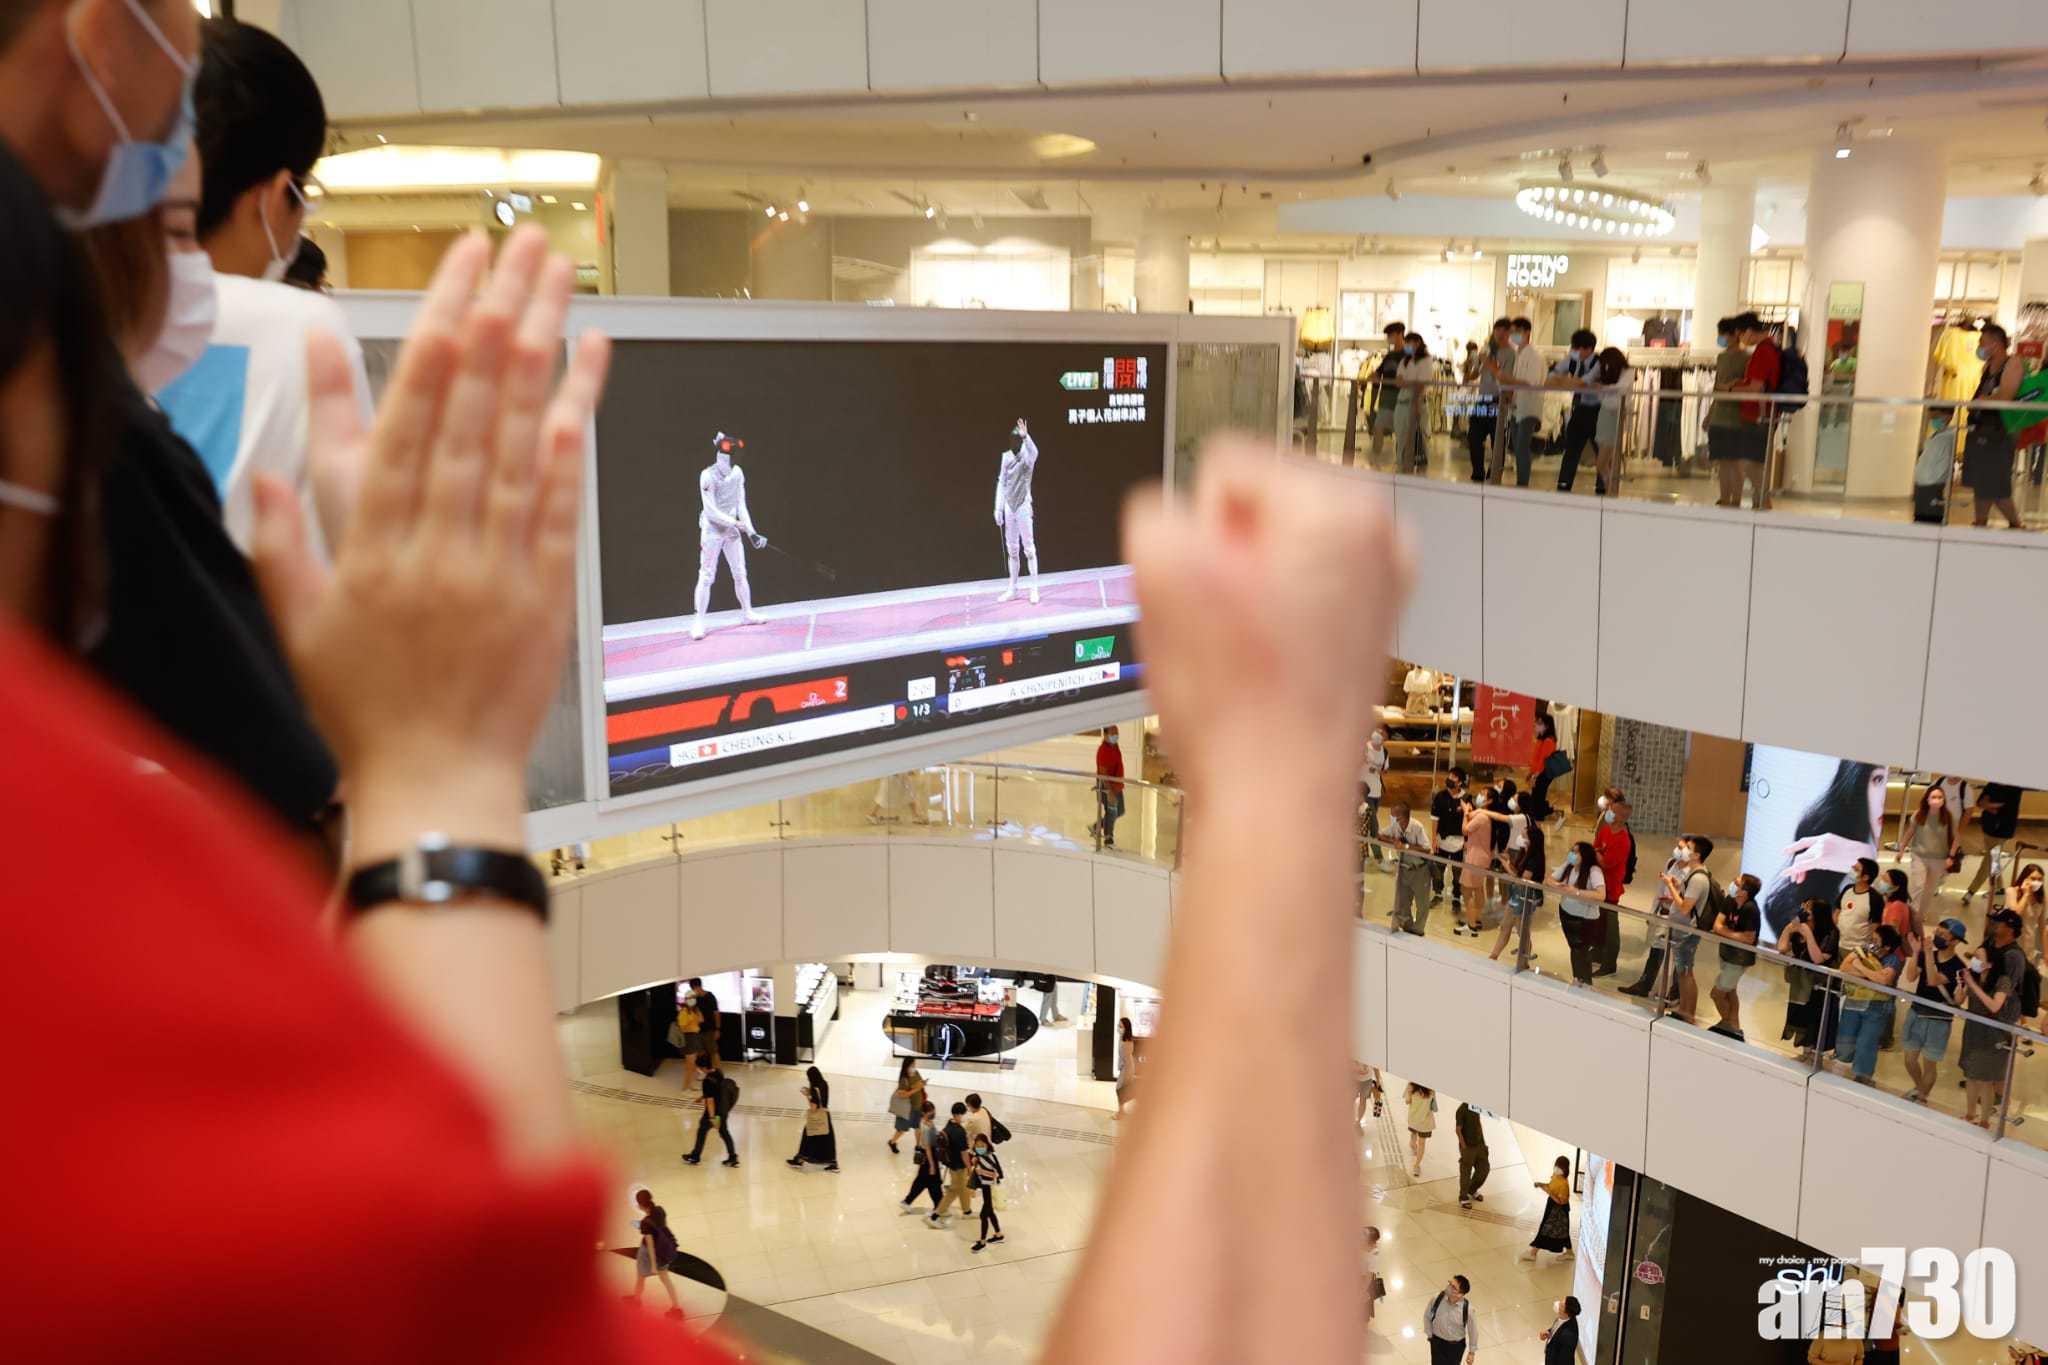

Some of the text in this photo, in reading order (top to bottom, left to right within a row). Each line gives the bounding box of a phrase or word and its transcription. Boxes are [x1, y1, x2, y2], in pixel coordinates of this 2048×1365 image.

[1507, 254, 1569, 274] FITTING
[1506, 269, 1556, 288] ROOM
[1067, 371, 1093, 388] LIVE
[835, 680, 847, 698] 2
[912, 702, 931, 718] 1/3
